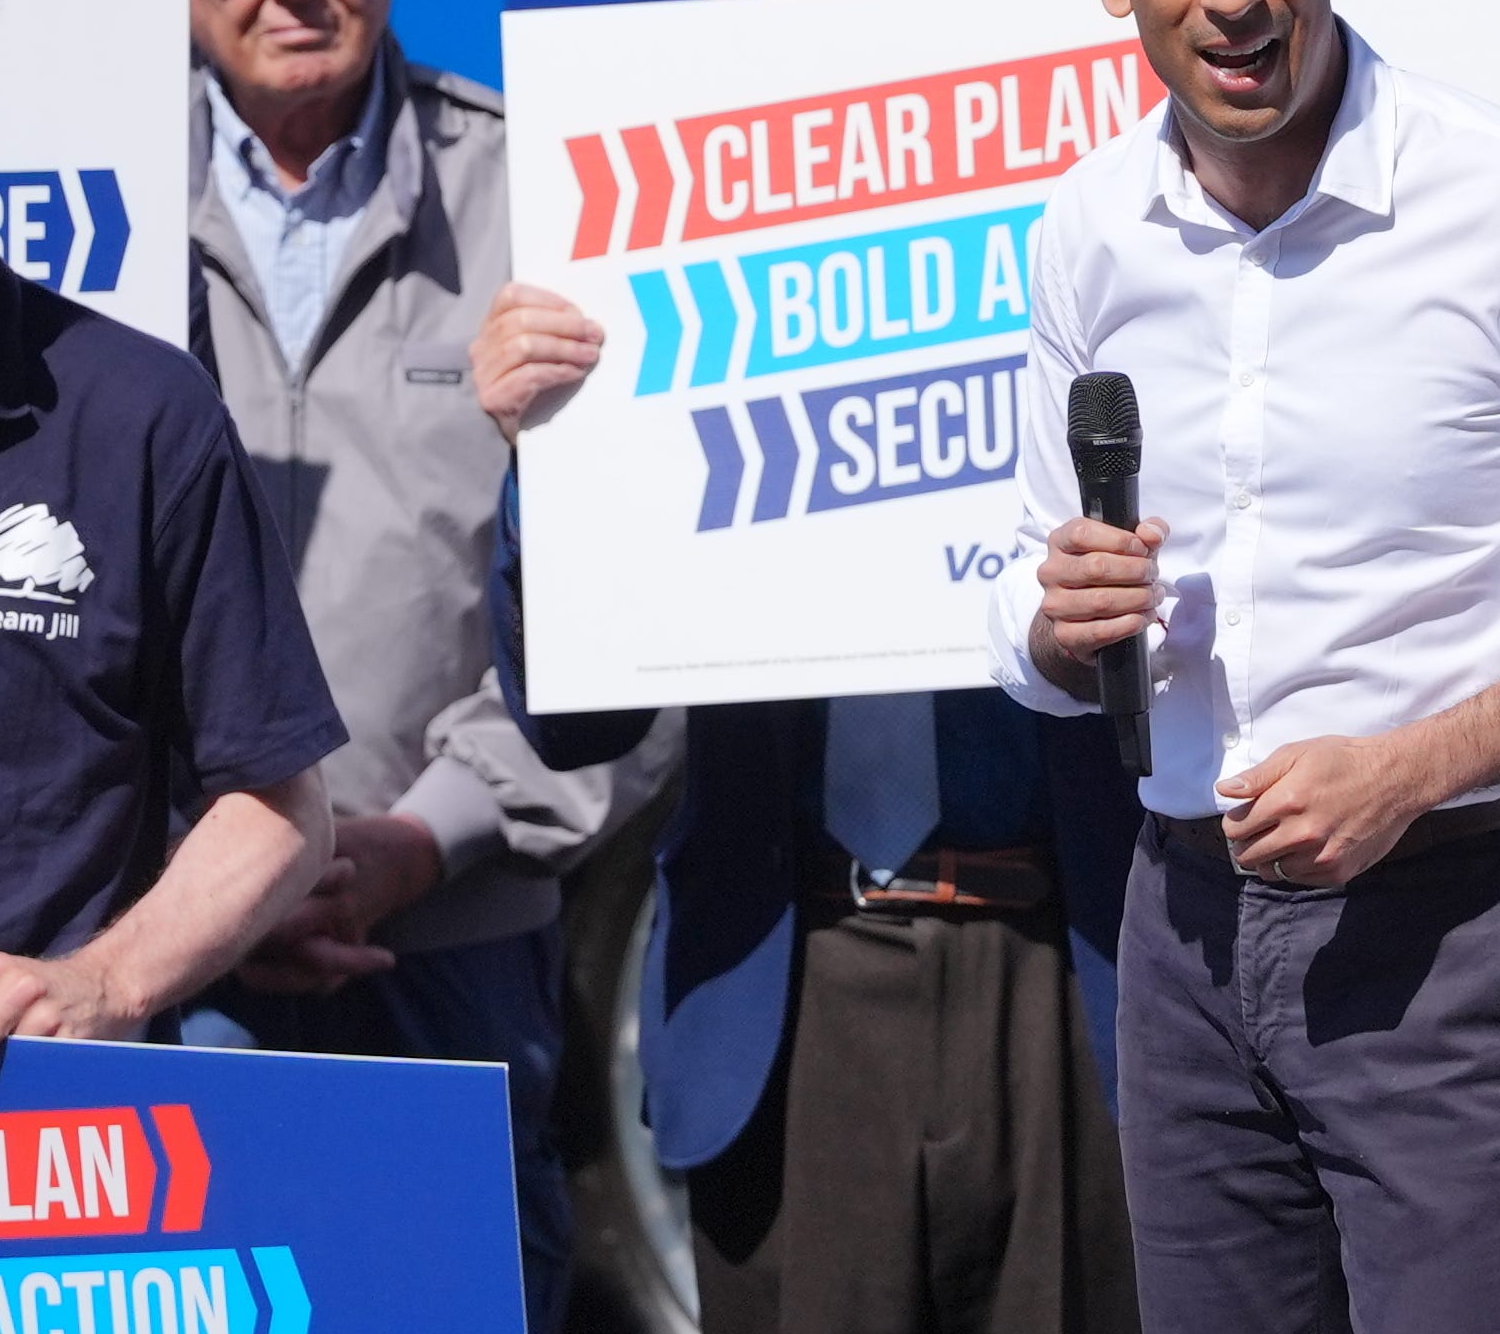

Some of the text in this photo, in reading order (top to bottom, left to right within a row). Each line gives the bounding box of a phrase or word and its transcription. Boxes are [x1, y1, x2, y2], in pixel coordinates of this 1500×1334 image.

[703, 51, 1141, 222] CLEAR PLAN
[770, 235, 956, 360] BOLD
[828, 367, 1027, 495] SECU
[945, 543, 1019, 582] Vo
[46, 611, 80, 641] Jill
